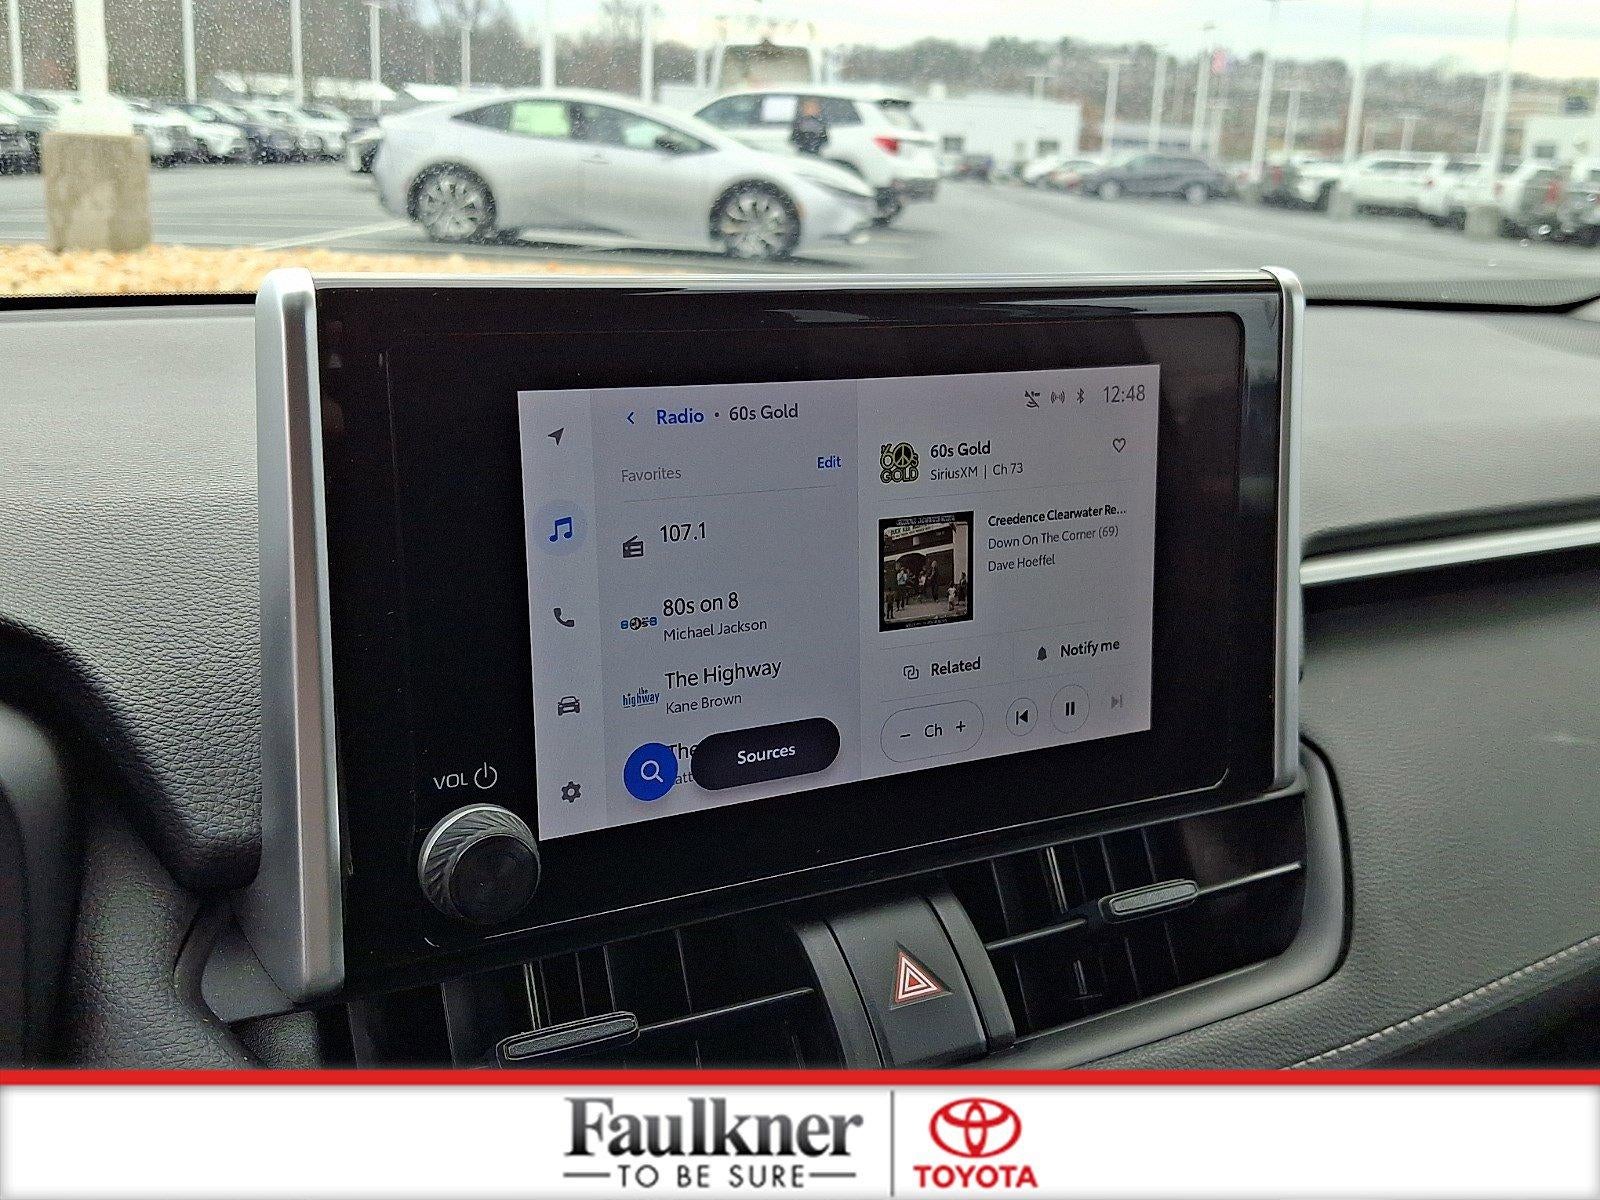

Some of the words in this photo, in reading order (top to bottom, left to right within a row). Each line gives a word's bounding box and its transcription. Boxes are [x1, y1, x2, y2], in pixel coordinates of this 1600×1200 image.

[1103, 384, 1146, 403] 12:48
[656, 408, 705, 425] Radio
[729, 406, 757, 421] 60s
[760, 403, 799, 420] Gold
[930, 443, 954, 459] 60s
[958, 440, 991, 457] Gold
[817, 454, 842, 469] Edit
[621, 466, 682, 483] Favorites
[880, 467, 919, 483] GOLD
[930, 466, 978, 481] SiriusXM
[992, 463, 1008, 476] Ch
[1010, 462, 1024, 474] 73
[988, 511, 1046, 527] Creedence
[1047, 506, 1103, 521] Clearwater
[659, 522, 707, 542] 107.1
[988, 536, 1020, 550] Down
[1022, 533, 1039, 546] On
[1040, 531, 1060, 544] The
[1061, 529, 1096, 543] Corner
[1098, 526, 1119, 540] (69)
[988, 558, 1015, 572] Dave
[1017, 554, 1056, 569] Hoeffel
[663, 597, 695, 617] 80s
[700, 596, 723, 612] on
[728, 592, 739, 609] 8
[663, 623, 715, 642] Michael
[717, 618, 768, 636] Jackson
[1060, 640, 1099, 658] Notify
[1101, 639, 1120, 653] me
[665, 670, 699, 690] The
[703, 660, 782, 686] Highway
[931, 656, 981, 677] Related
[622, 692, 660, 708] highway
[665, 699, 699, 715] Kane
[701, 693, 742, 710] Brown
[924, 723, 943, 738] Ch
[737, 744, 796, 765] Sources
[433, 772, 469, 790] VOL
